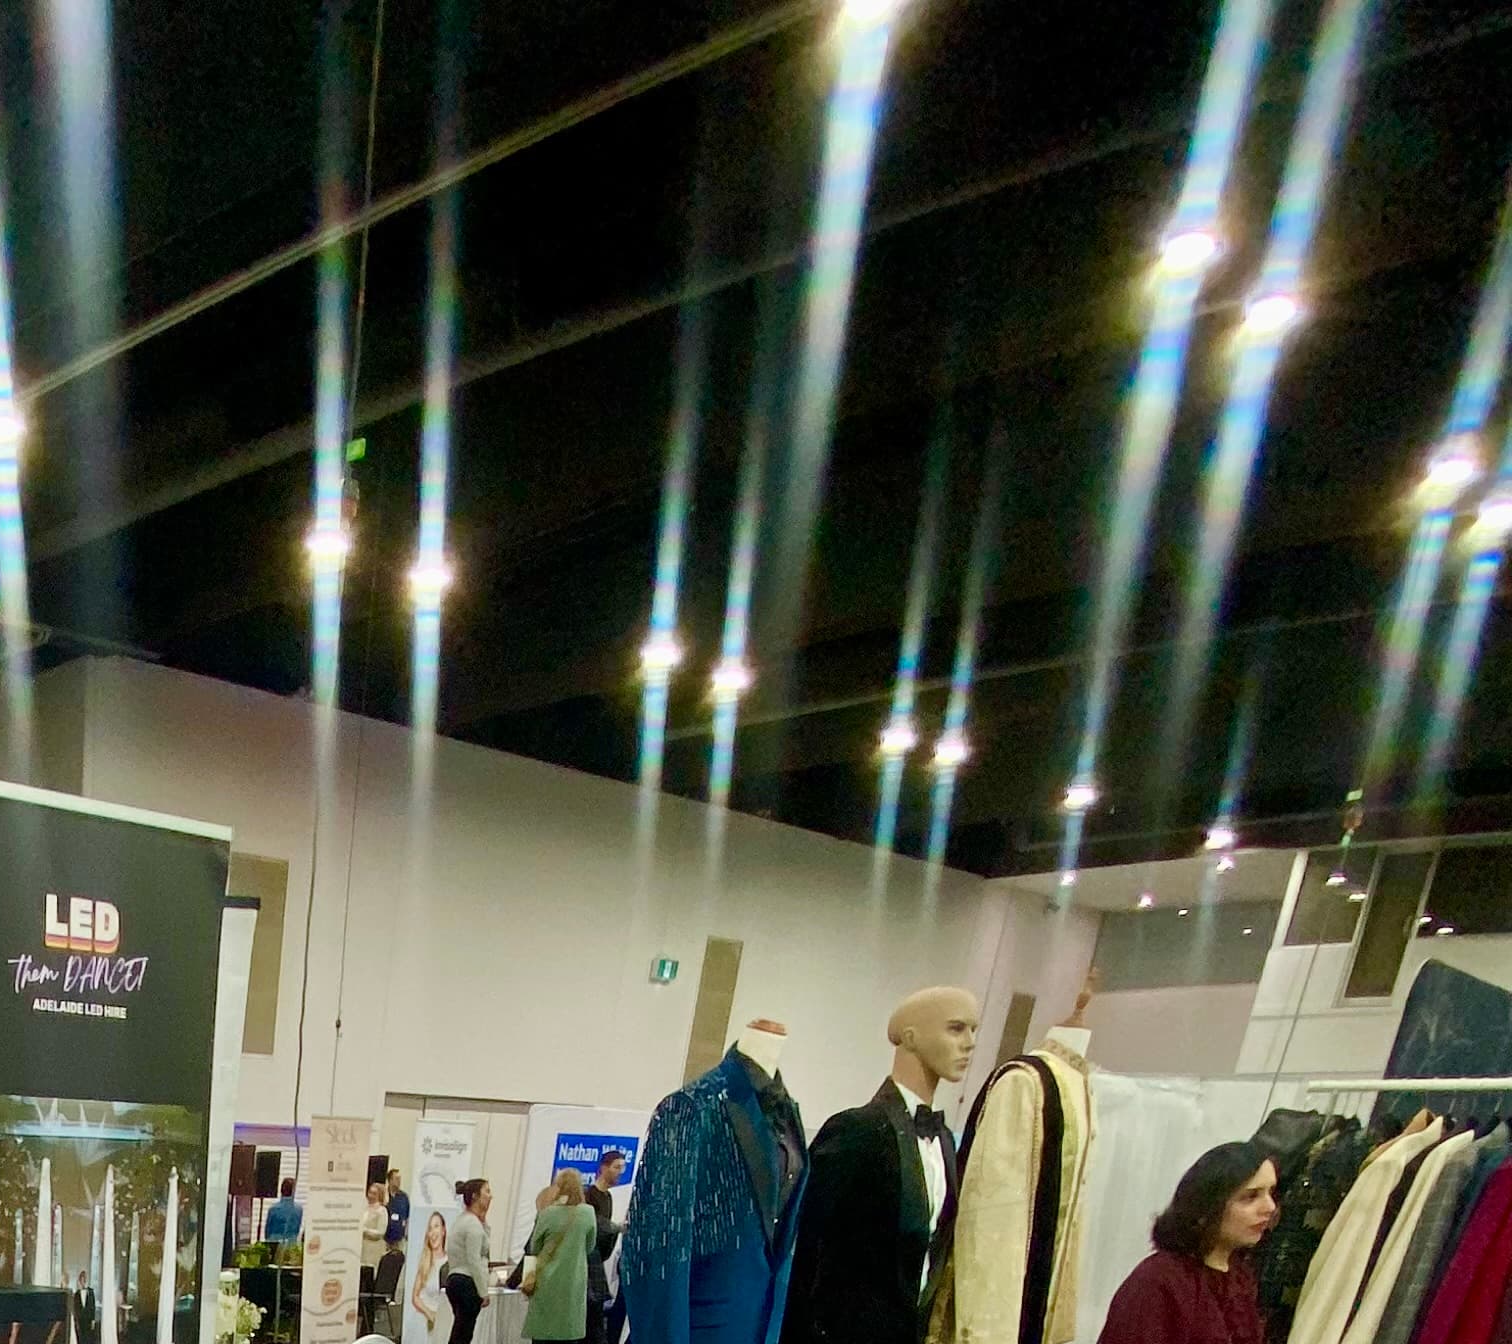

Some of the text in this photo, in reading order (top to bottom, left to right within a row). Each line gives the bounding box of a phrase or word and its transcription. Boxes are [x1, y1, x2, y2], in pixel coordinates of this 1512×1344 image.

[45, 893, 120, 954] LED
[33, 998, 127, 1019] ADELAIDE LED HIRE
[558, 1142, 599, 1162] Nathan
